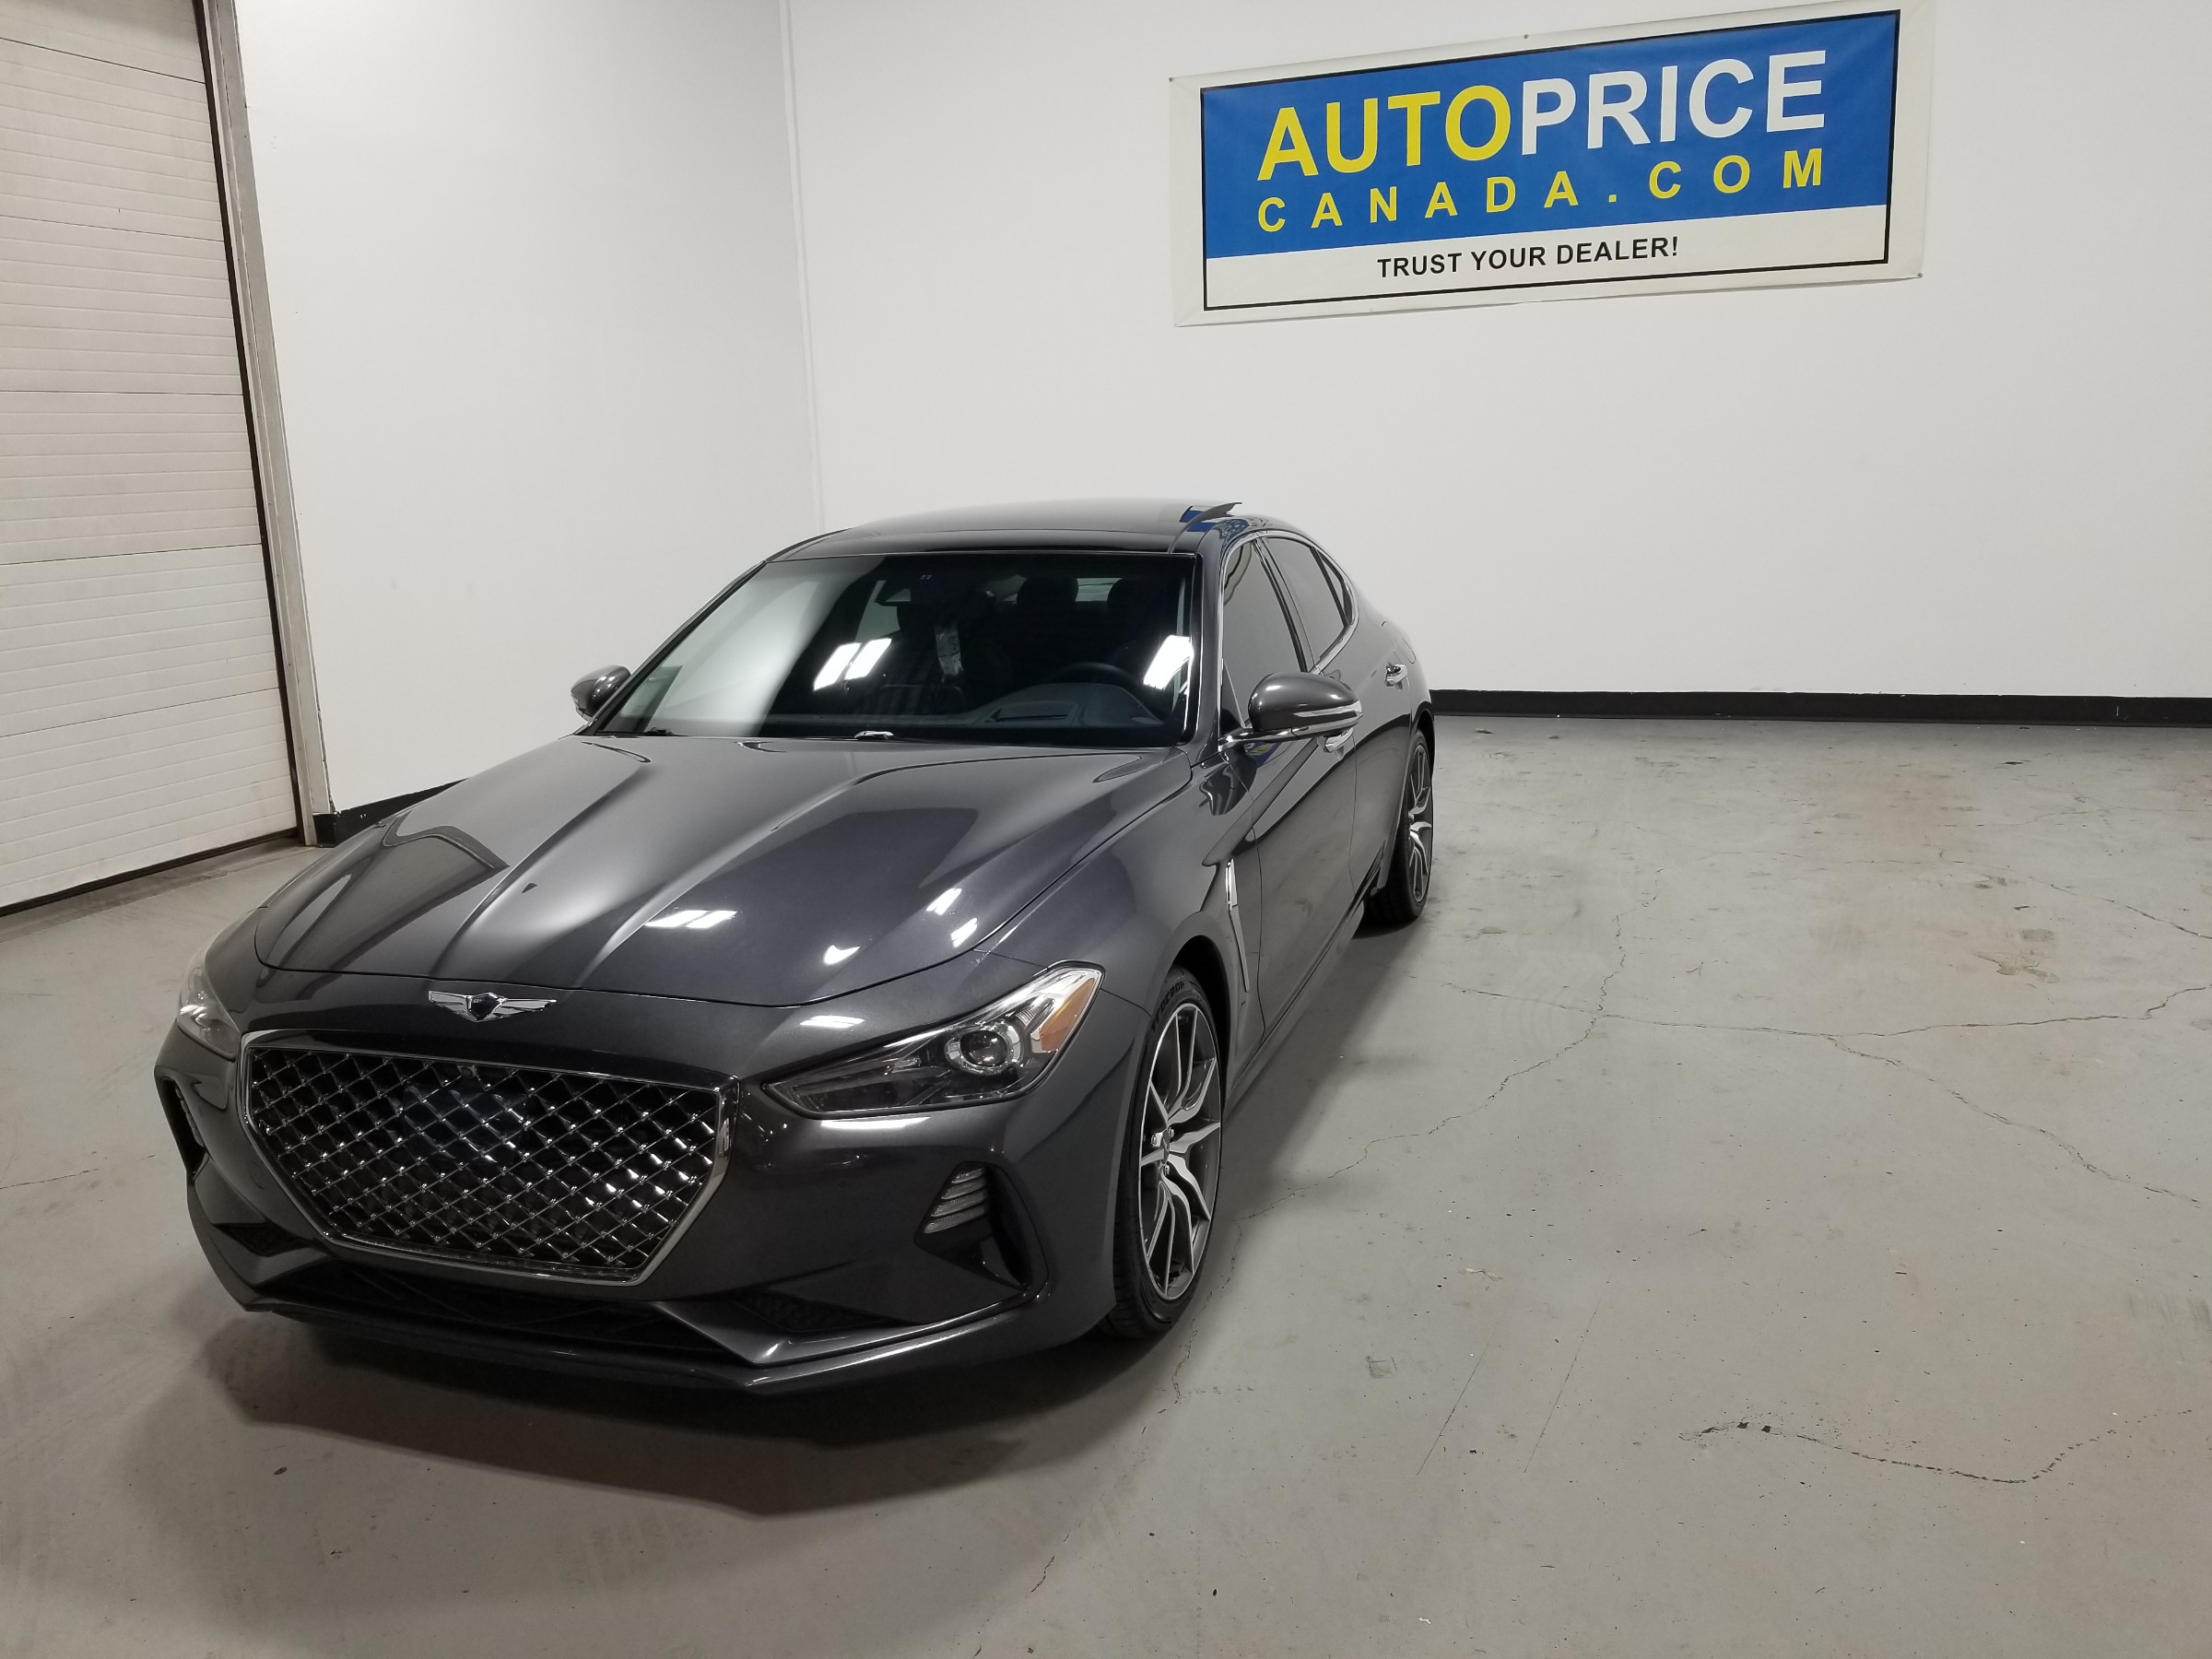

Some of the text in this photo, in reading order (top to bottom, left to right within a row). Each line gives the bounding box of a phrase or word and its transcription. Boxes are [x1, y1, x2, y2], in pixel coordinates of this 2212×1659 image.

[1257, 50, 1827, 182] AUTOPRICE
[1258, 147, 1823, 233] CANADA.COM
[1377, 236, 1679, 278] TRUST YOUR DEALER!
